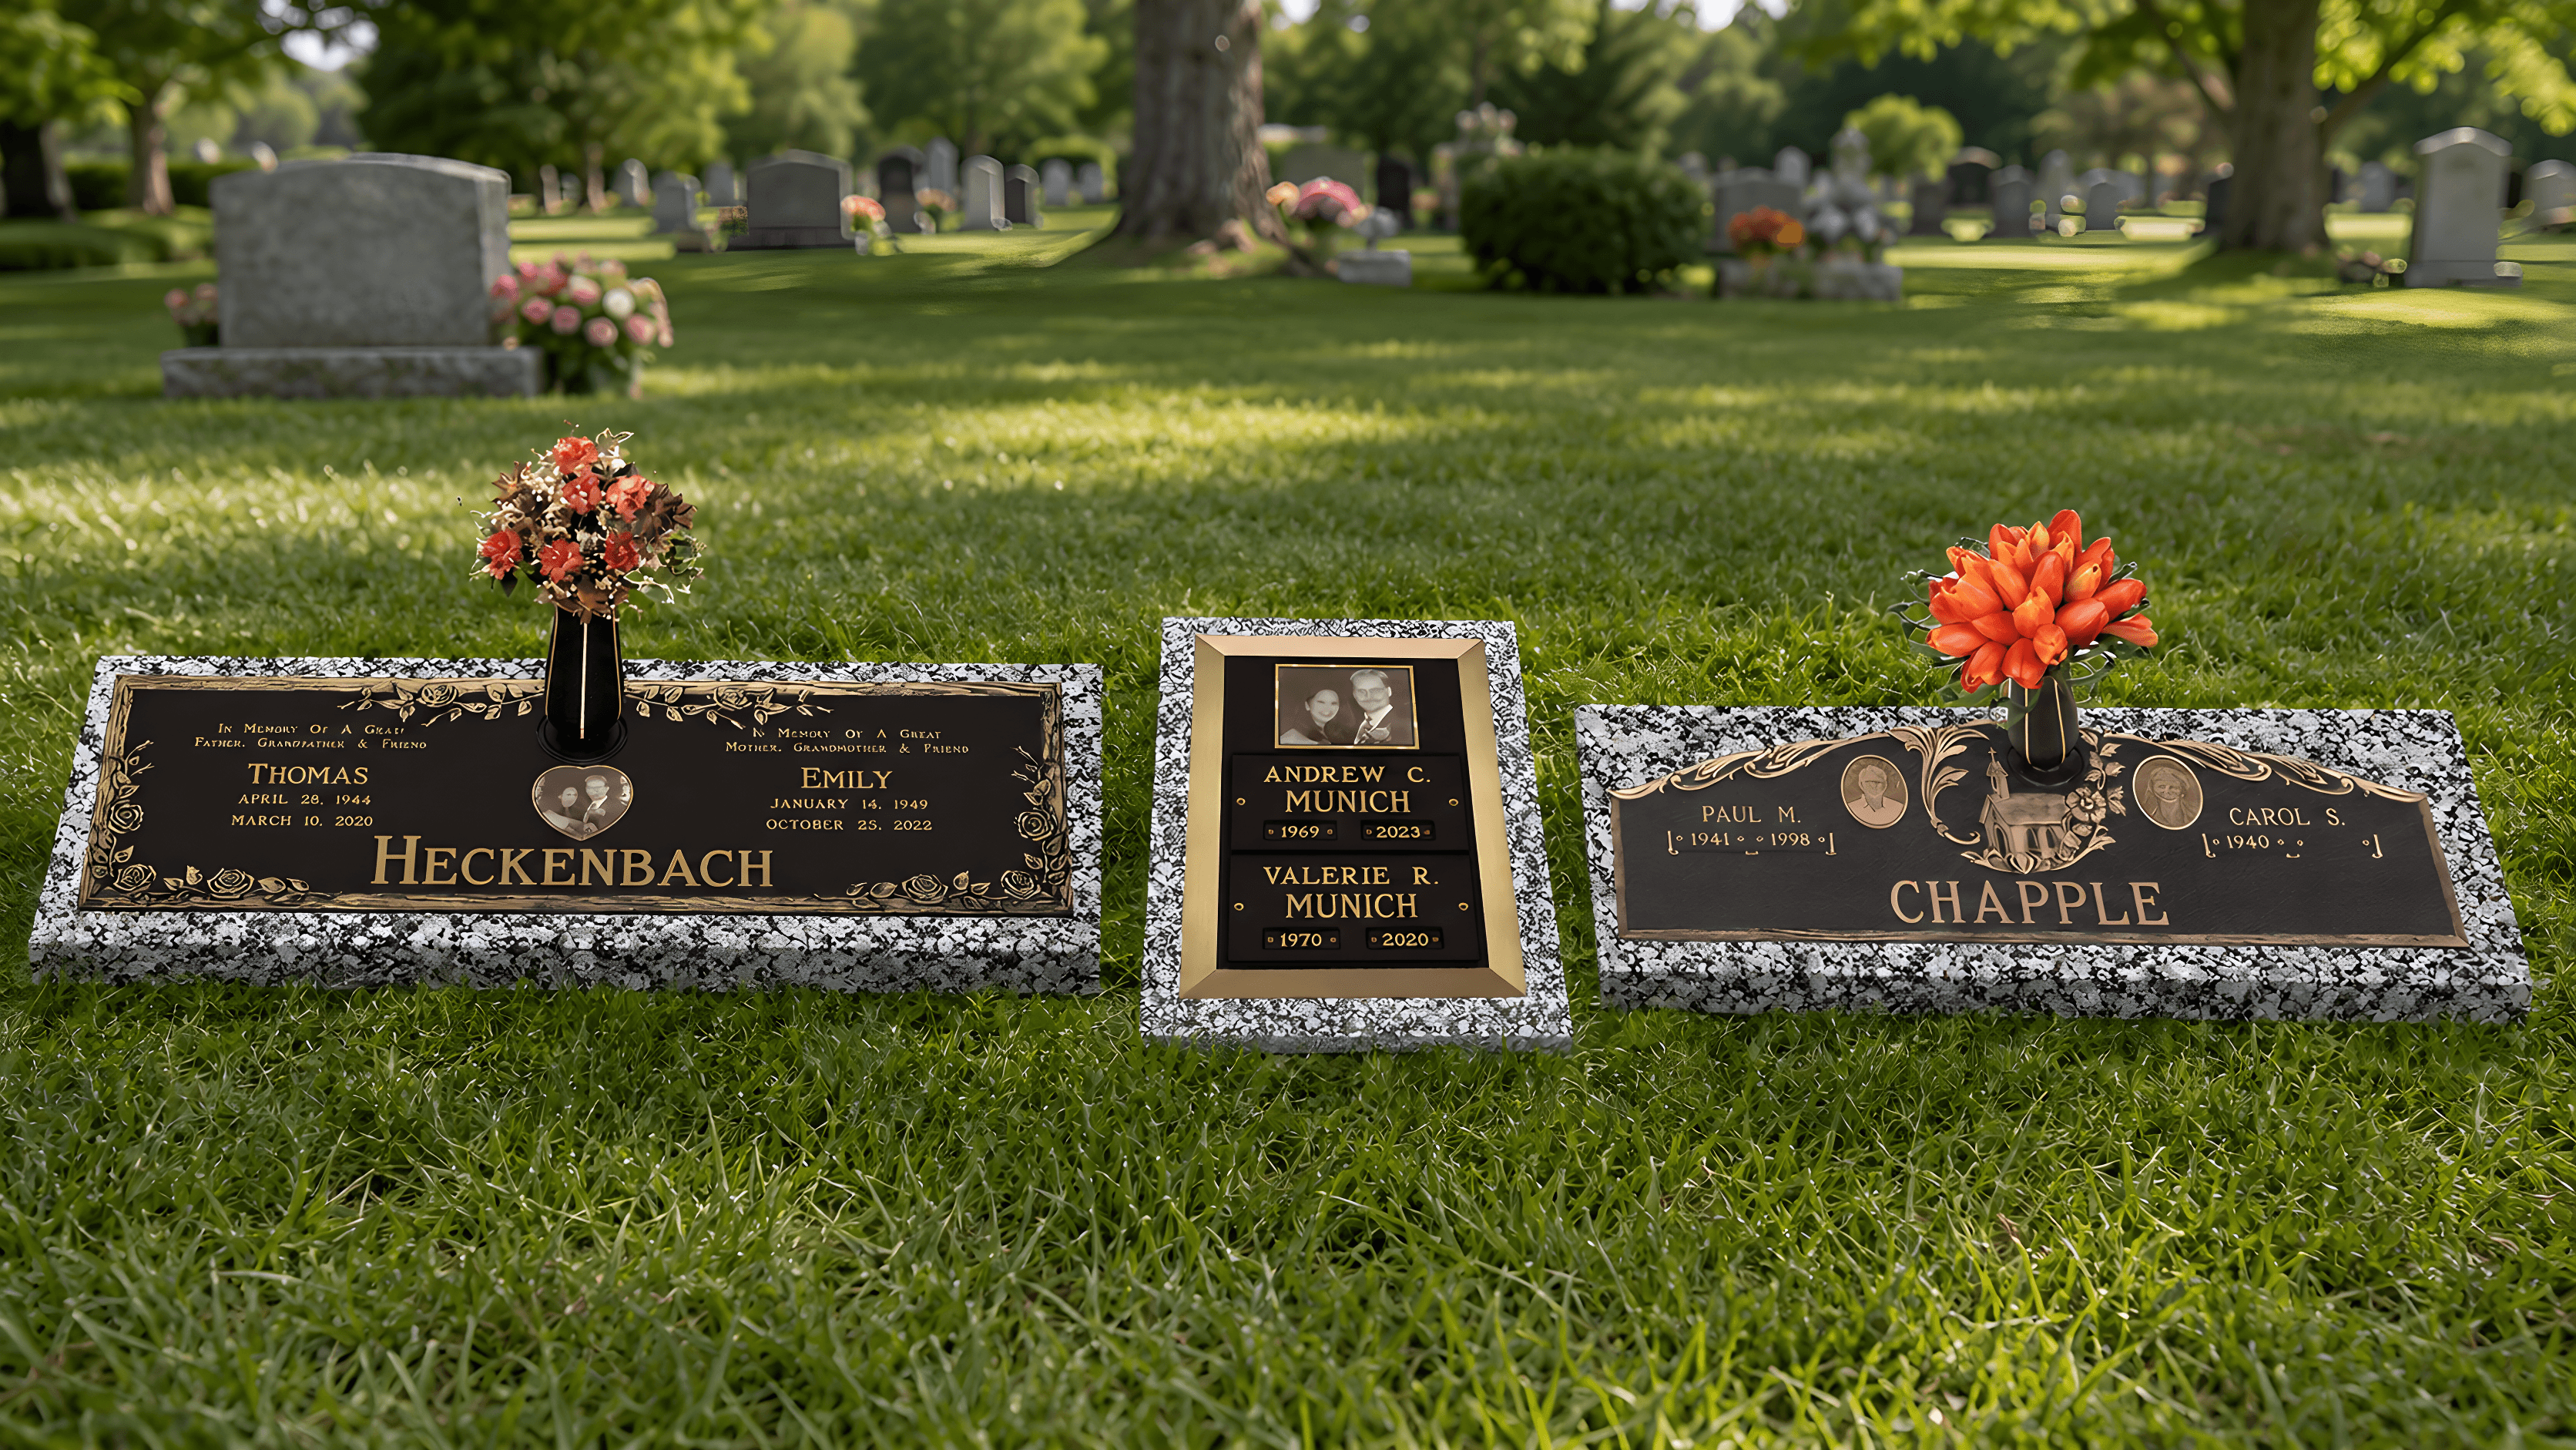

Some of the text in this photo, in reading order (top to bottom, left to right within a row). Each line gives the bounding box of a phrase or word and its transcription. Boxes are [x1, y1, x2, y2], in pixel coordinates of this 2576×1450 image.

[340, 723, 352, 735] A
[877, 728, 887, 739] A
[357, 738, 368, 749] &
[899, 743, 911, 754] &
[247, 763, 368, 785] THOMAS
[800, 767, 894, 789] EMILY
[1263, 765, 1431, 783] ANDREW C.
[237, 794, 289, 804] APRIL
[336, 794, 371, 805] 1944
[770, 797, 849, 810] JANUARY
[894, 799, 928, 810] 1949
[1285, 790, 1411, 813] MUNICH
[231, 814, 292, 826] MARCH
[334, 815, 374, 827] 2020
[1702, 805, 1801, 824] PAUL M.
[2229, 807, 2346, 826] CAROL S.
[766, 818, 844, 831] OCTOBER
[894, 820, 933, 831] 2022
[1281, 825, 1420, 838] 1969 2023
[1691, 832, 1811, 847] 1941 1998
[2226, 834, 2269, 849] 1940
[371, 835, 773, 887] HECKENBACH
[1263, 866, 1439, 885] VALERIE R.
[1285, 893, 1418, 918] MUNICH
[1890, 880, 2170, 926] CHAPPLE
[1280, 932, 1429, 948] 1970 2020
